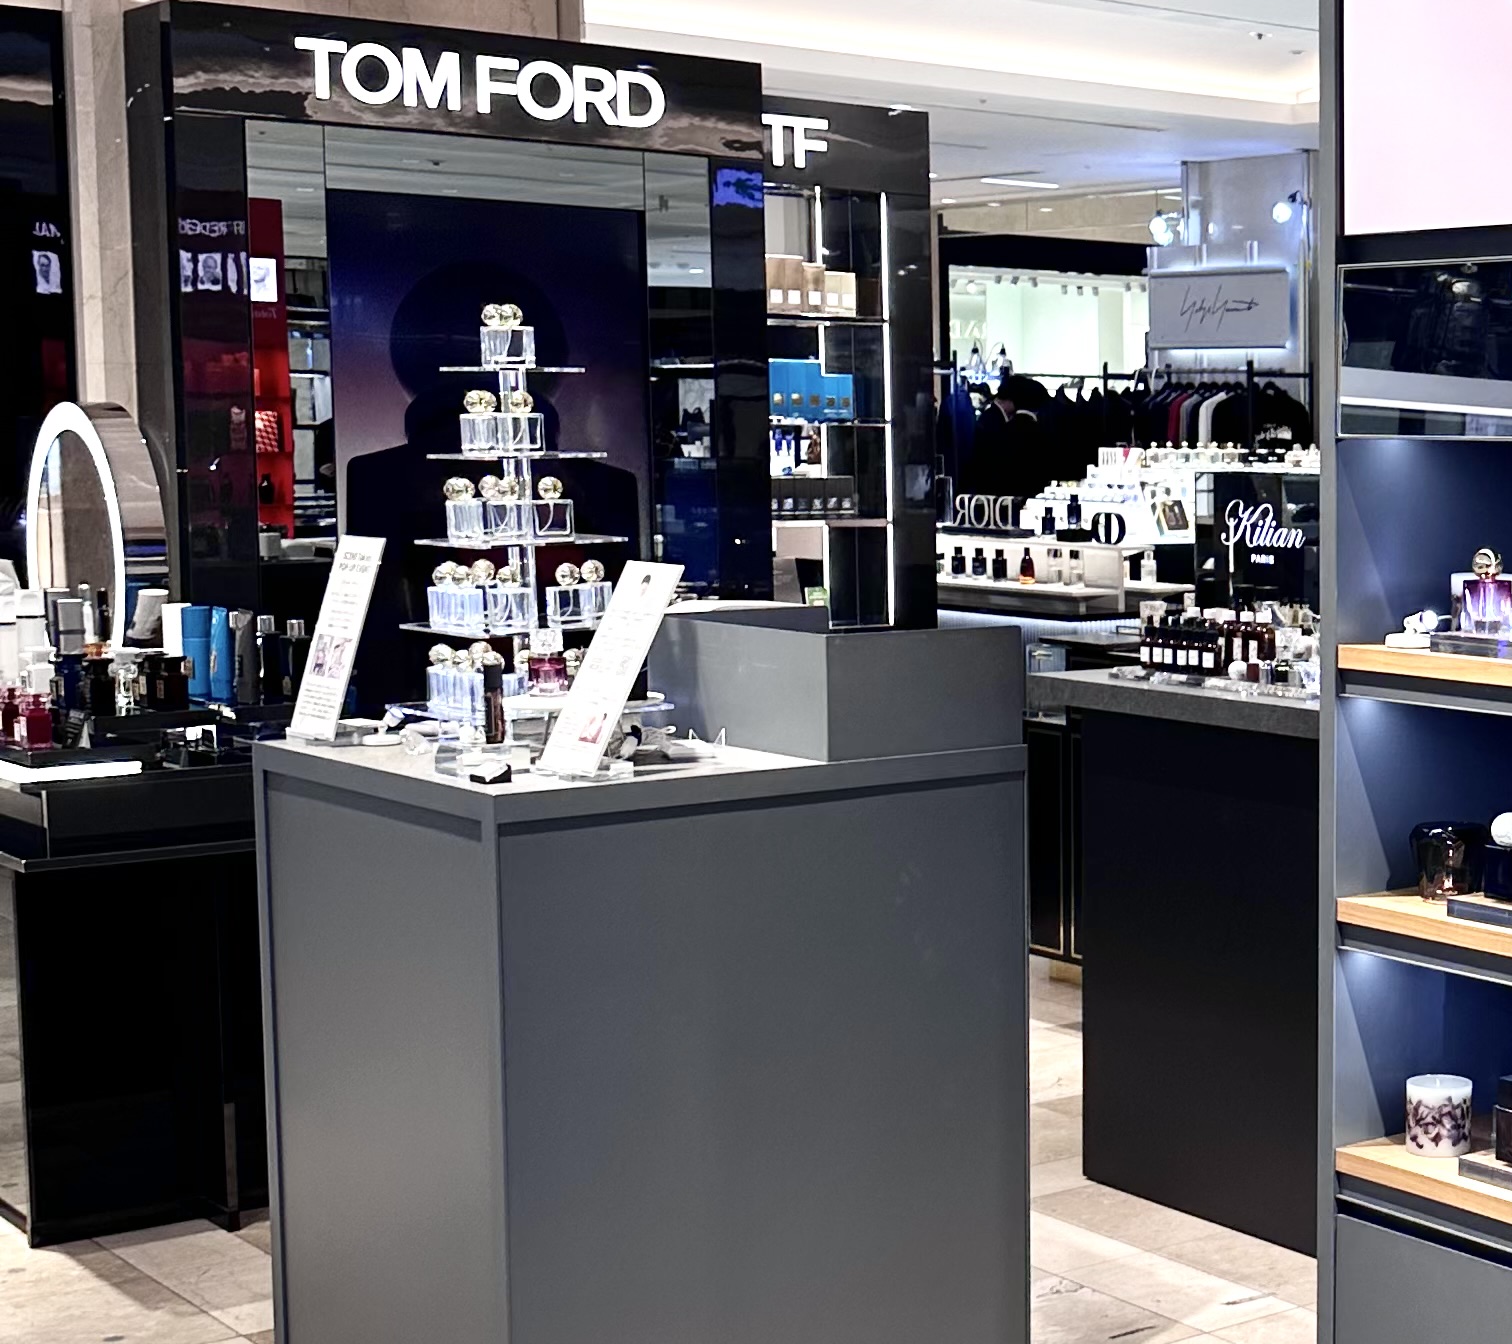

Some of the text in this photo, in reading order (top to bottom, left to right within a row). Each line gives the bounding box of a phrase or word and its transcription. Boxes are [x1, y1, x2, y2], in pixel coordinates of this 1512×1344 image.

[294, 35, 666, 129] TOM FORD
[761, 113, 829, 169] TF
[1220, 498, 1306, 549] Kilian
